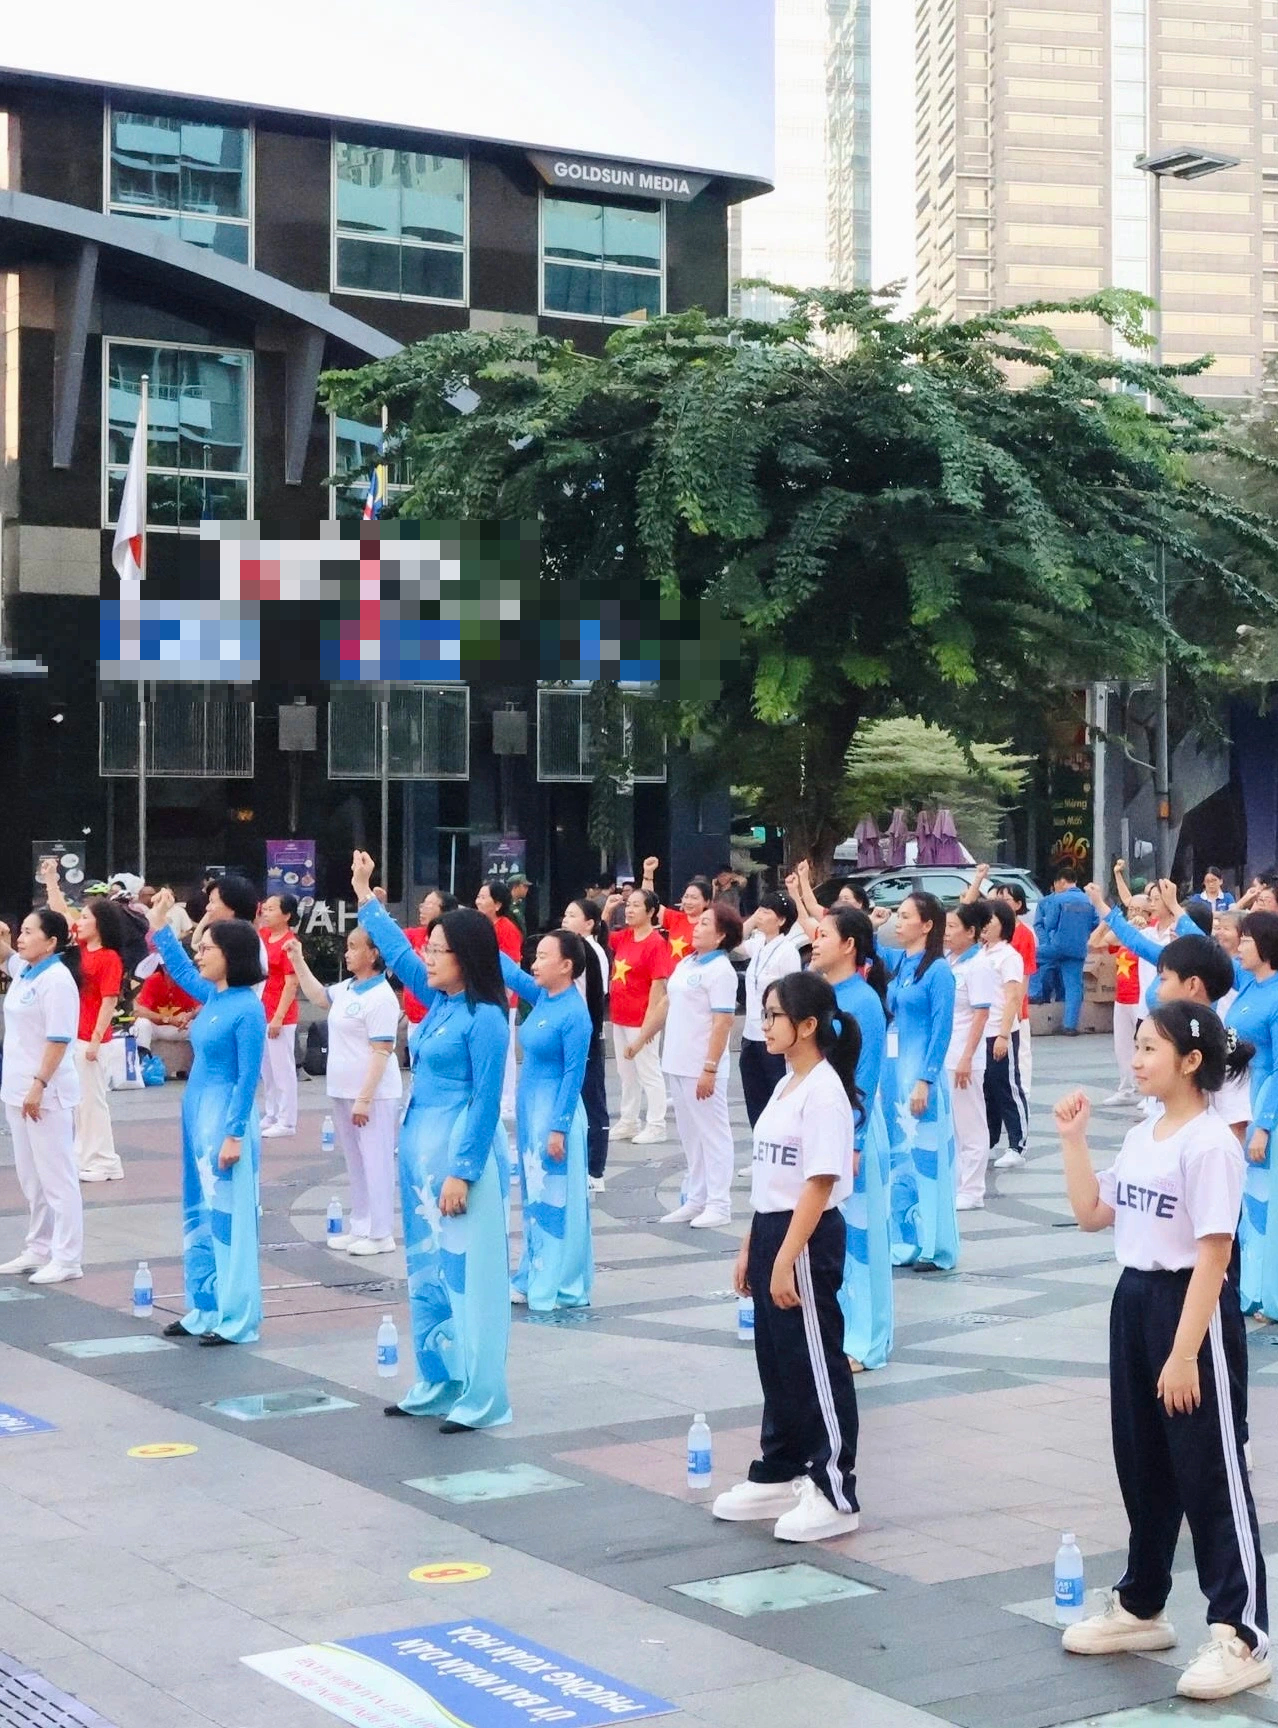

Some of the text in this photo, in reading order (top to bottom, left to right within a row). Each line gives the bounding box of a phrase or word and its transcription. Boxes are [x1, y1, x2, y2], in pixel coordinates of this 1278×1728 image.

[554, 162, 691, 194] GOLDSUN MEDIA
[391, 1638, 454, 1661] DÂN
[431, 1658, 508, 1688] NHÂN
[446, 1625, 647, 1713] PHƯỜNG XUÂN HÒA
[485, 1684, 550, 1708] BAN
